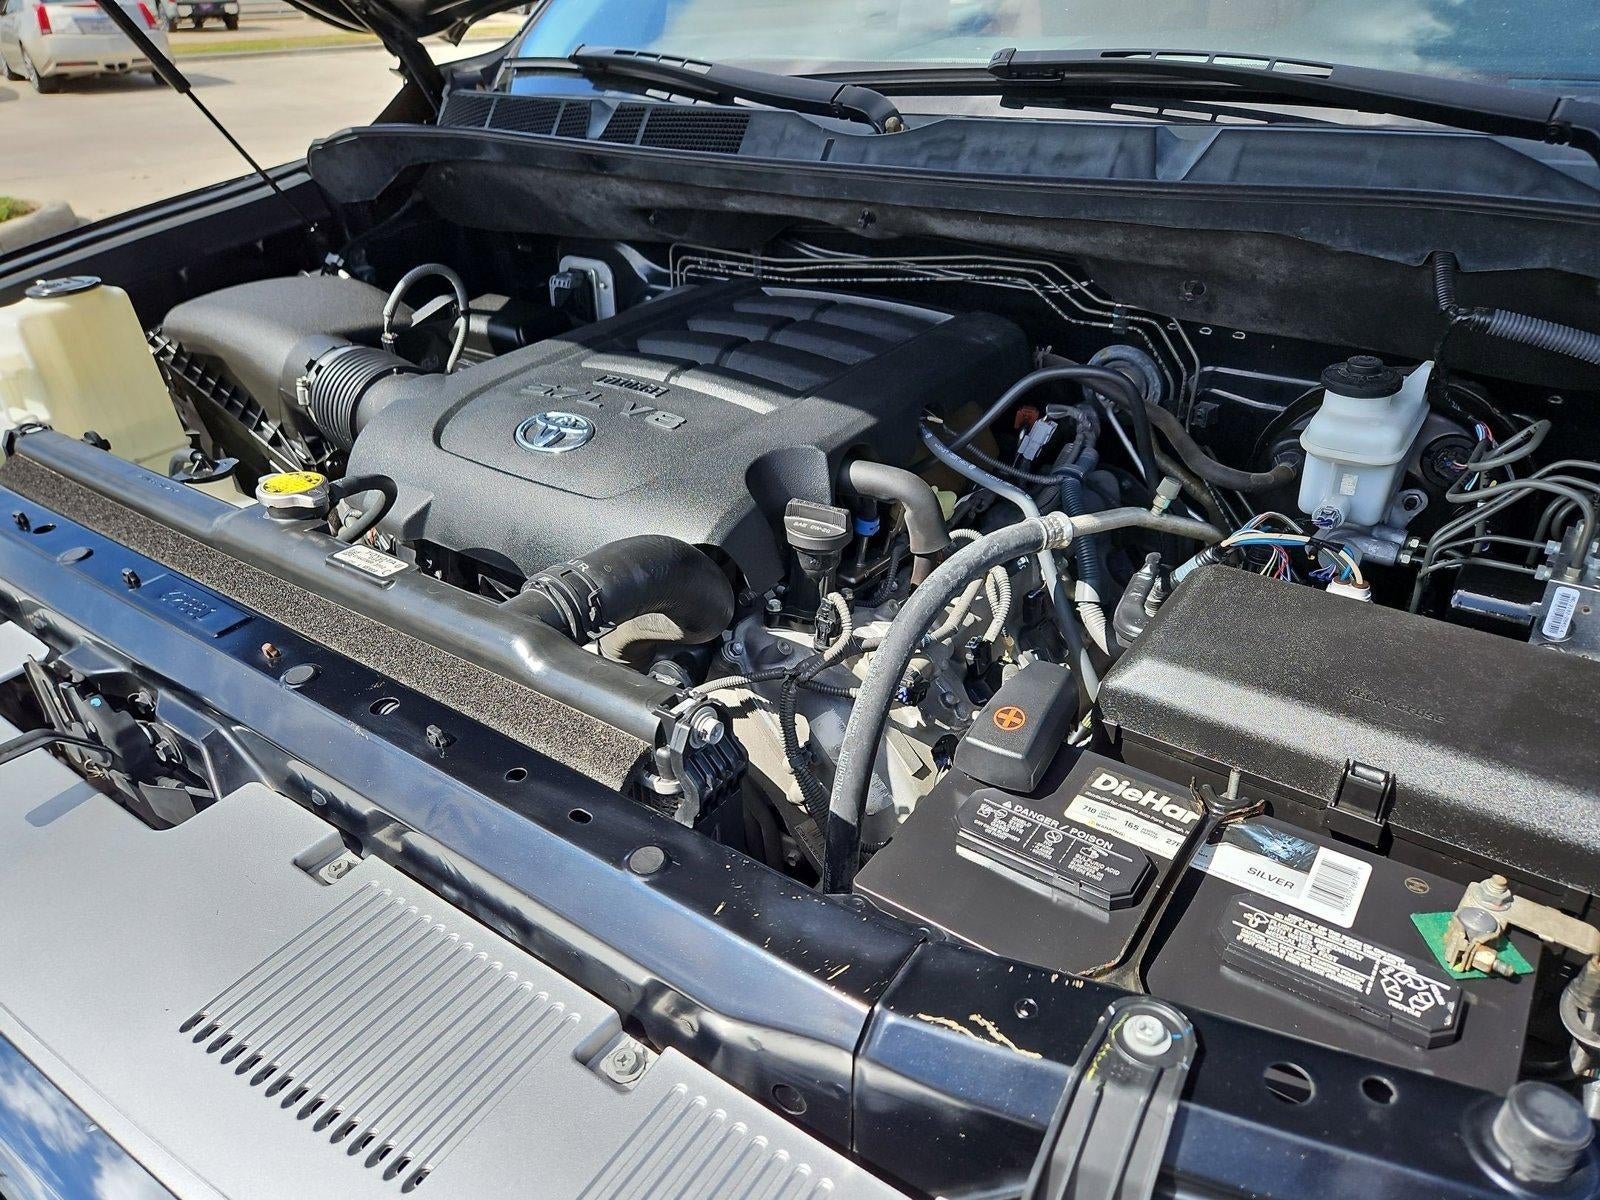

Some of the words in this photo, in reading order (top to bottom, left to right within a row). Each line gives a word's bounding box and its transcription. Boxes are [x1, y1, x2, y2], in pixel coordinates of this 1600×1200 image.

[620, 402, 688, 430] V8
[838, 750, 850, 791] NICHIRIN
[1082, 804, 1097, 814] 710
[1091, 773, 1201, 825] DieHar
[1013, 804, 1060, 828] DANGER
[1069, 827, 1113, 850] POISON
[1123, 820, 1139, 831] 165
[1074, 853, 1105, 870] SULFURIC
[1104, 866, 1120, 876] ACID
[1247, 867, 1295, 889] SILVER
[1268, 918, 1293, 932] FLUSH
[1317, 950, 1338, 963] FAST
